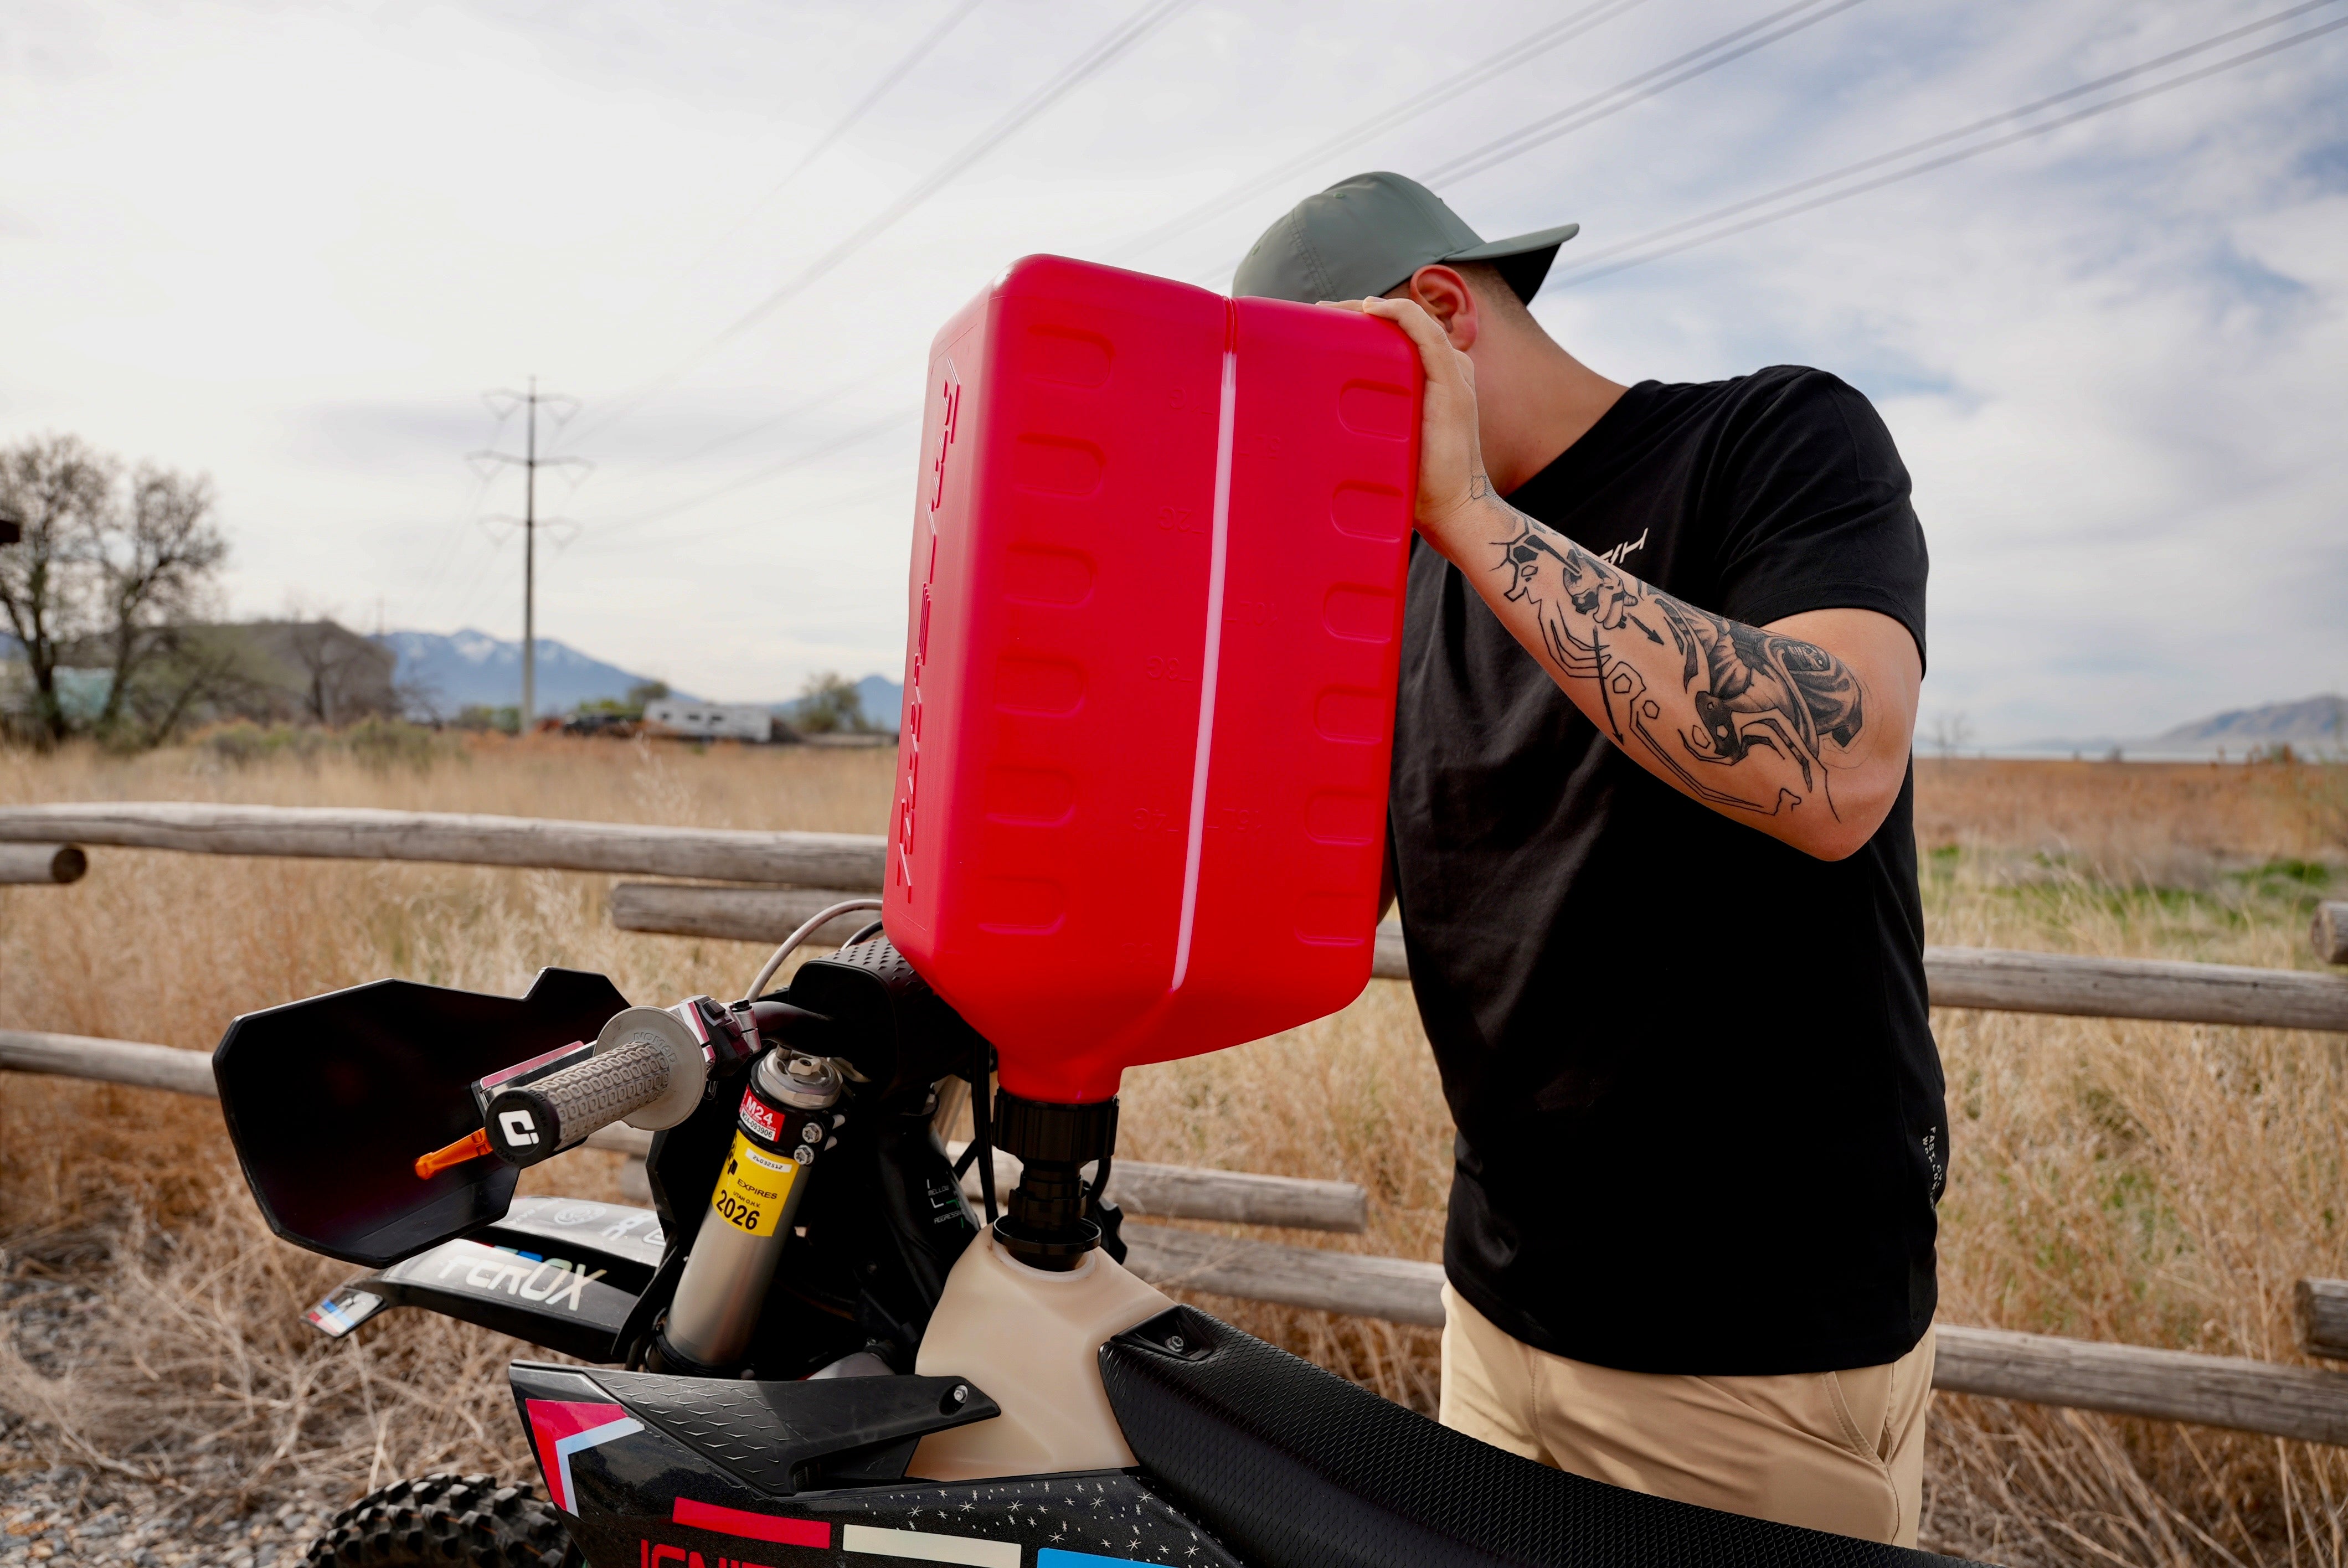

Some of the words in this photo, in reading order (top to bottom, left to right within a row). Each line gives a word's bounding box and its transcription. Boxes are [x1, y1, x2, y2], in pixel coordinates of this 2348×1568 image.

[633, 1031, 678, 1064] NOMAD
[742, 1110, 774, 1138] M24-093906
[745, 1095, 774, 1126] M24
[733, 1191, 746, 1202] UTAH
[737, 1178, 778, 1200] EXPIRES
[716, 1189, 760, 1230] 2026
